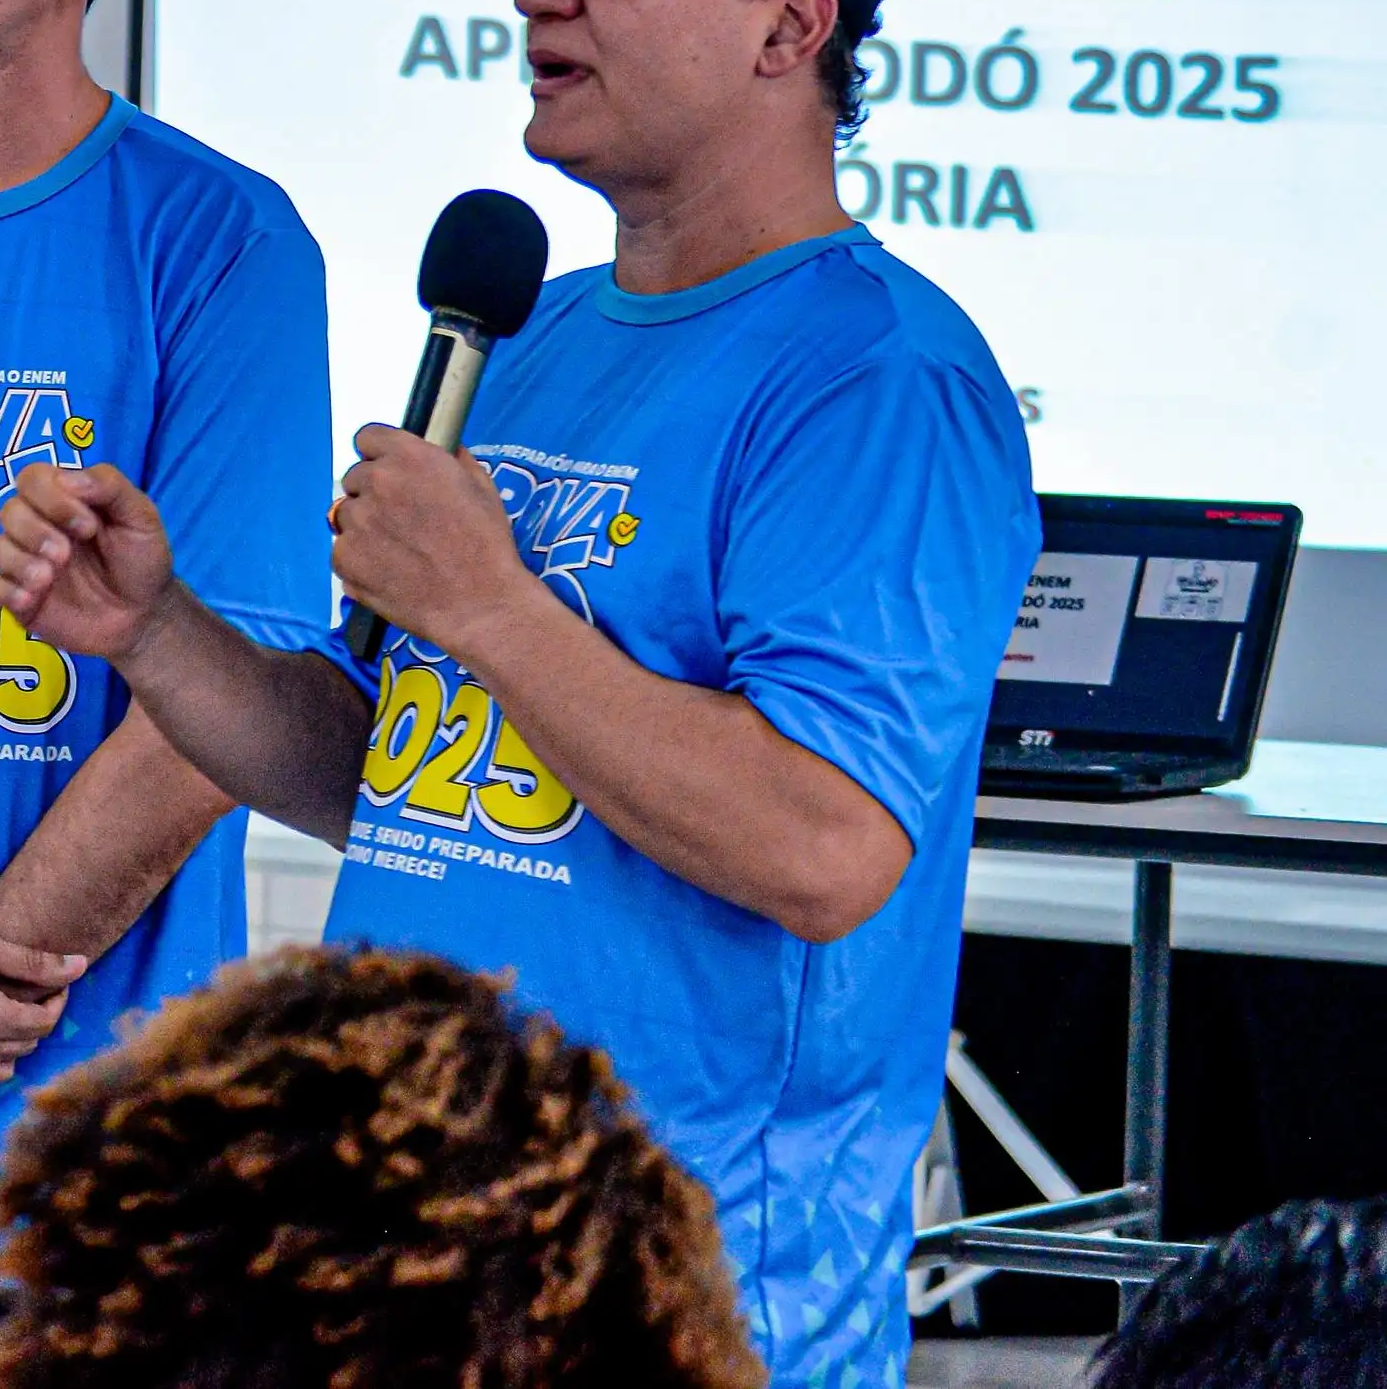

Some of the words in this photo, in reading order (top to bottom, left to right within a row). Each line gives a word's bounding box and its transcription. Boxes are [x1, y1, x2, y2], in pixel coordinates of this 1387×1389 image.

[859, 27, 1039, 112] ODÓ
[1069, 46, 1281, 123] 2025
[7, 369, 21, 383] O
[22, 370, 67, 385] ENEM
[374, 826, 426, 852] SENDO
[427, 837, 573, 886] PREPARADA
